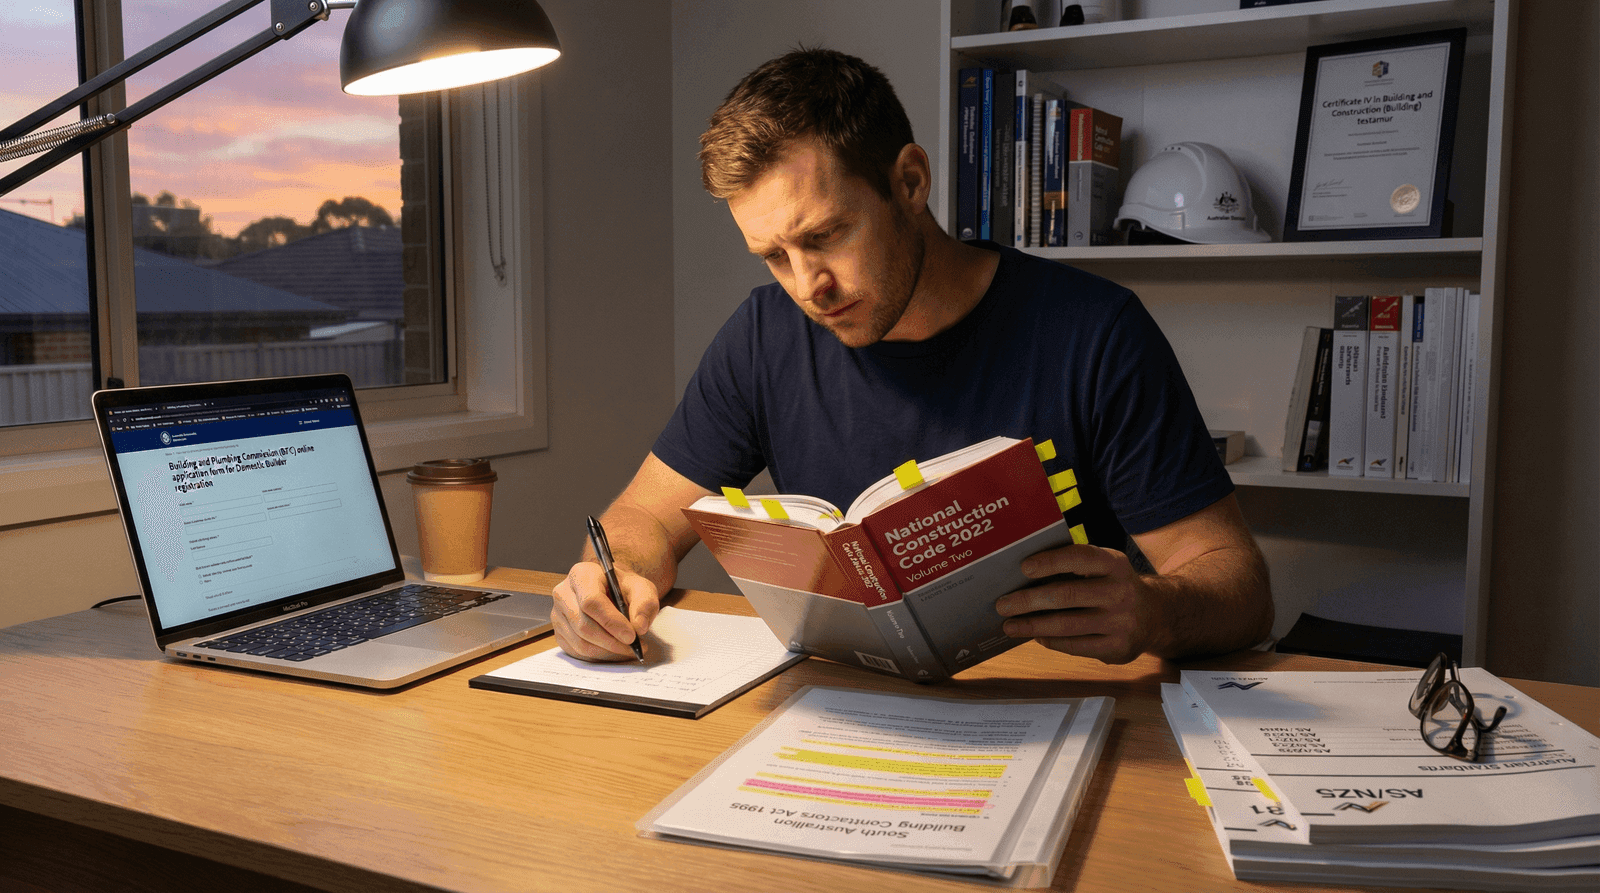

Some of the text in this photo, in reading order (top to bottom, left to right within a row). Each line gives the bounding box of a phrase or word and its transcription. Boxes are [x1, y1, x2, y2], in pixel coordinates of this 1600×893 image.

[1322, 98, 1362, 109] Certificate
[1363, 96, 1372, 104] IV
[1416, 90, 1433, 99] and
[1331, 105, 1382, 117] Construction
[1357, 116, 1394, 125] testamur
[168, 459, 198, 471] Building
[198, 458, 211, 468] and
[210, 454, 243, 465] Plumbing
[296, 445, 315, 454] online
[172, 469, 209, 482] application
[208, 467, 226, 477] form
[225, 463, 236, 474] for
[235, 460, 265, 472] Domestic
[174, 479, 214, 493] registration
[884, 499, 962, 545] National
[892, 497, 1010, 556] Construction
[899, 518, 994, 570] Code 2022
[906, 549, 973, 583] Volume Two
[729, 802, 765, 813] 1995
[770, 807, 798, 818] Act
[860, 829, 910, 839] South
[898, 820, 967, 833] Building
